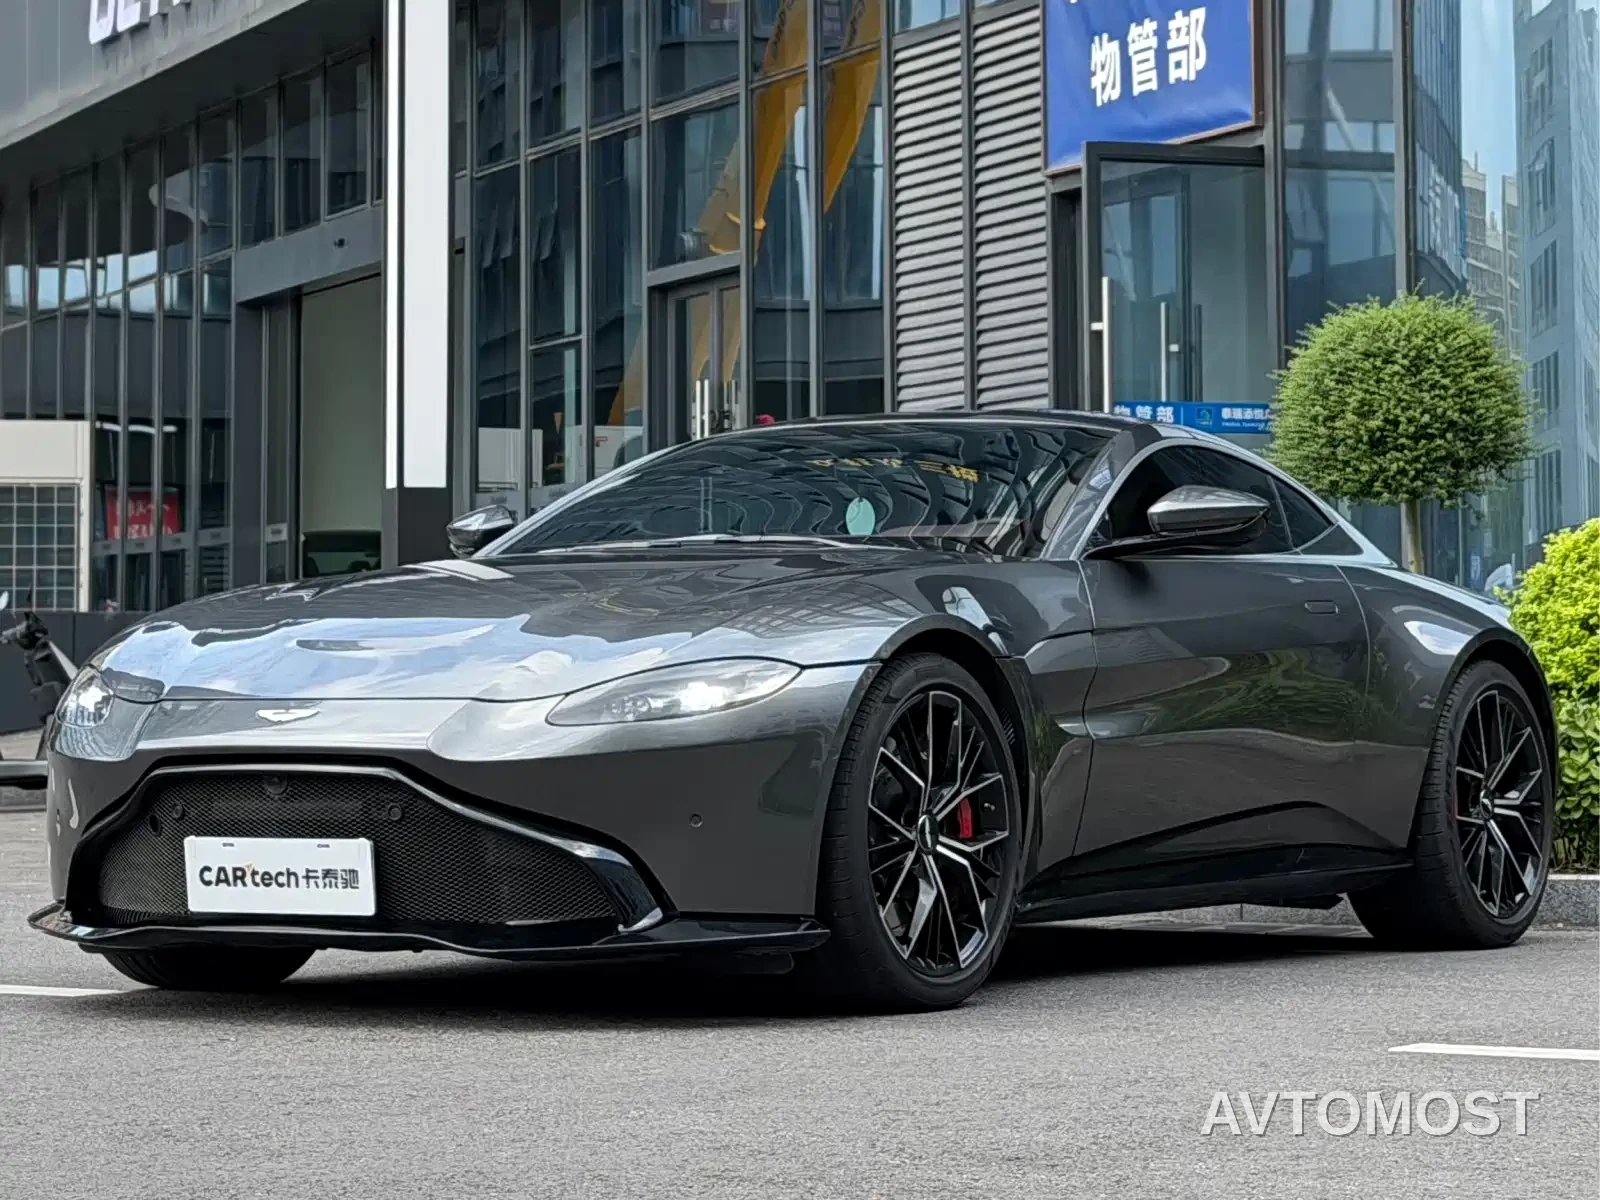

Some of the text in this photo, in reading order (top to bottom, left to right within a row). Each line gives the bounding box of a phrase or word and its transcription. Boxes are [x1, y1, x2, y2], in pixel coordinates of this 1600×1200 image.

[1090, 7, 1207, 107] 物管部
[199, 862, 360, 890] CARtech 卡泰驰
